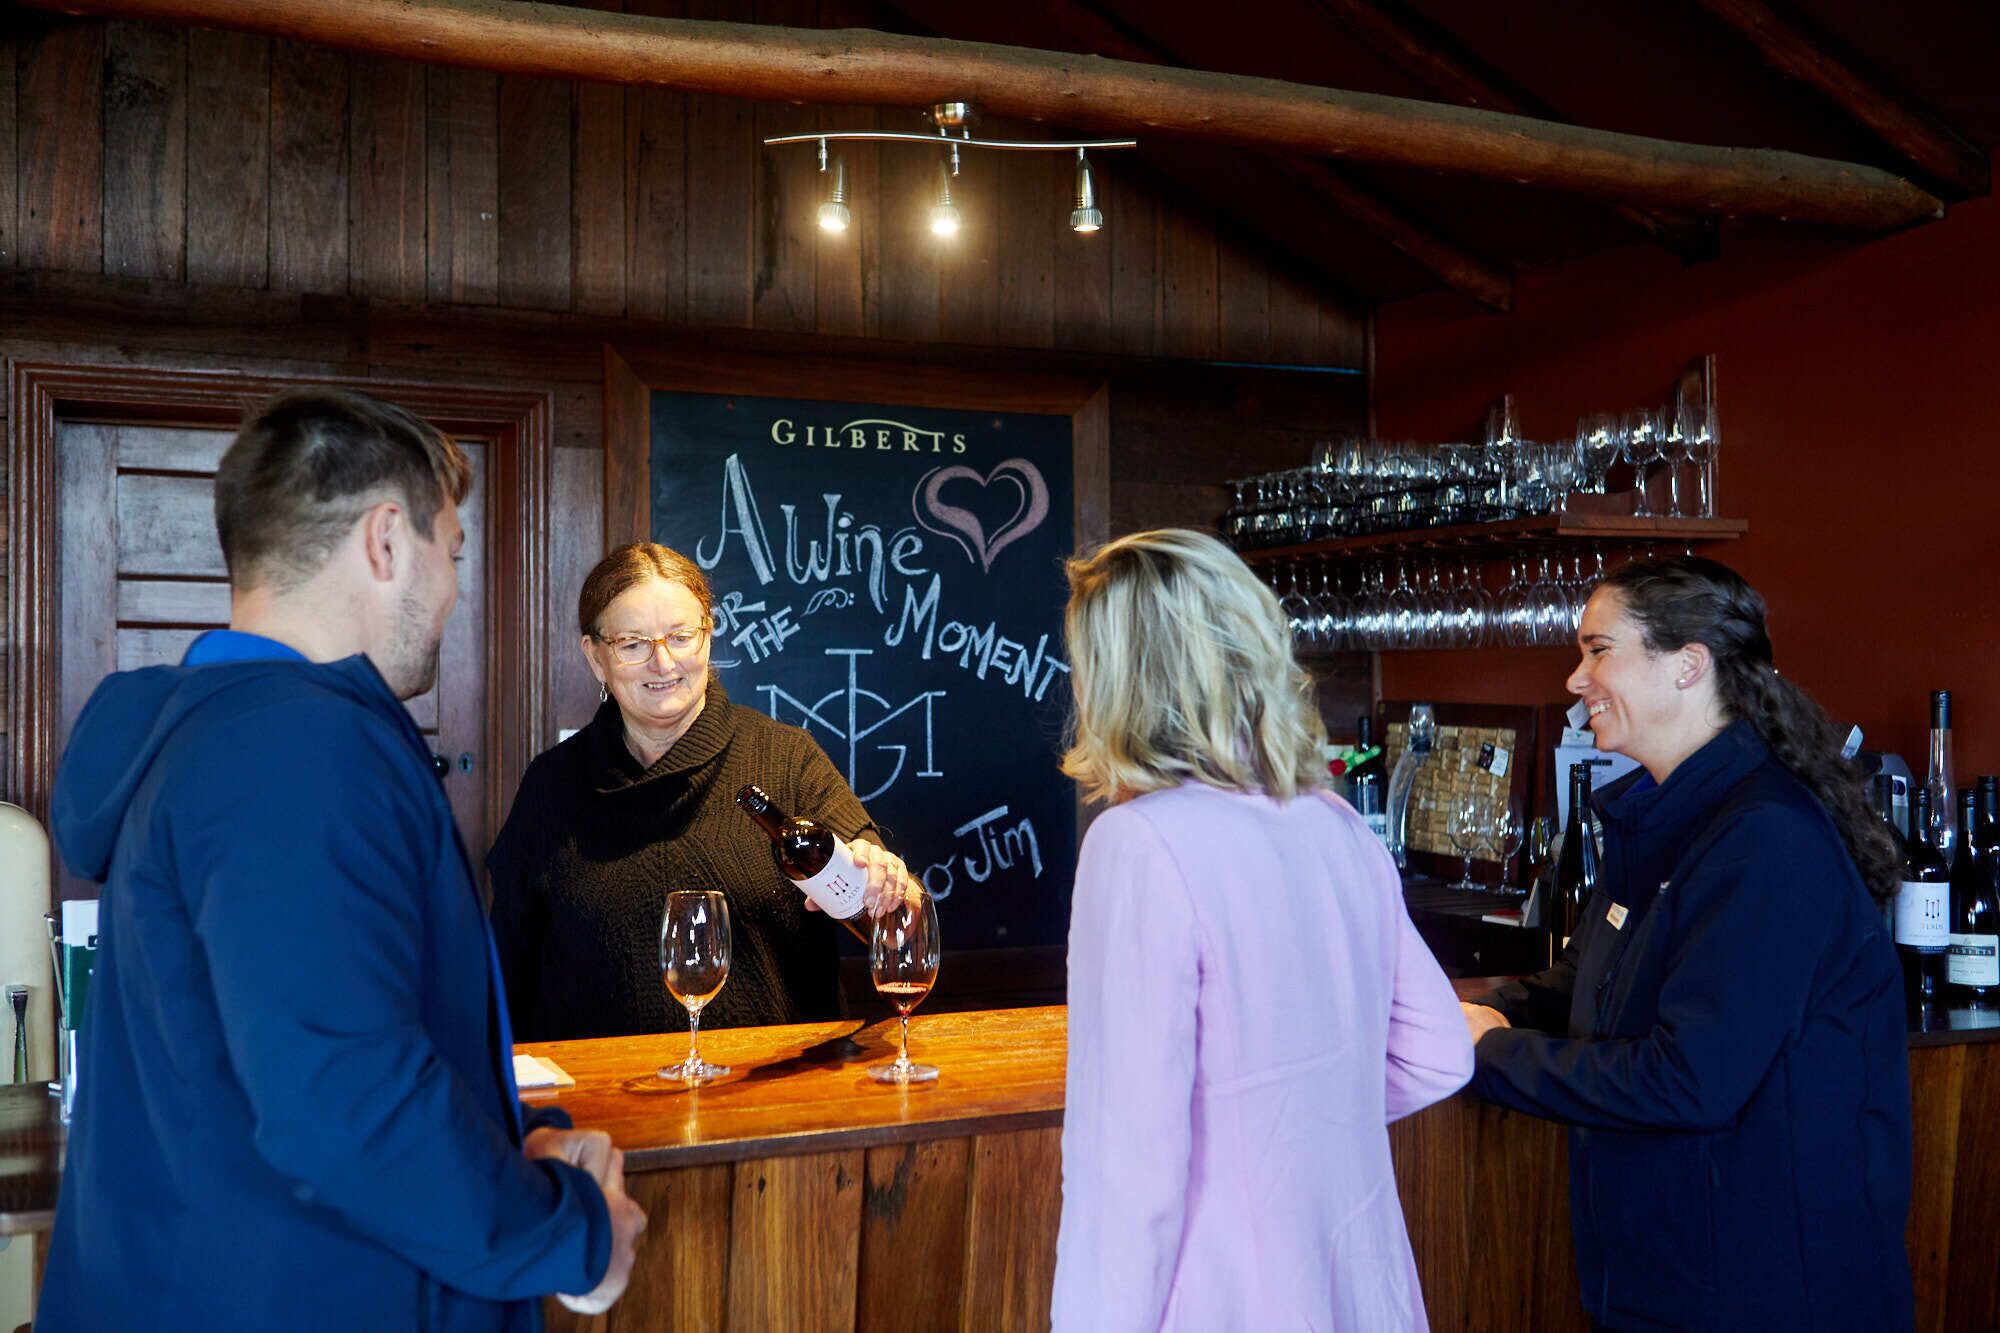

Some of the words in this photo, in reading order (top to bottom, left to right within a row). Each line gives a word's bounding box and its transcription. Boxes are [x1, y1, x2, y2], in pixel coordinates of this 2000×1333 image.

[771, 418, 967, 454] GILBERTS
[696, 453, 776, 585] A
[780, 493, 930, 614] Wine
[710, 591, 766, 637] OR
[731, 605, 801, 664] THE
[884, 573, 1072, 702] MOMENT
[953, 804, 1043, 883] Jim
